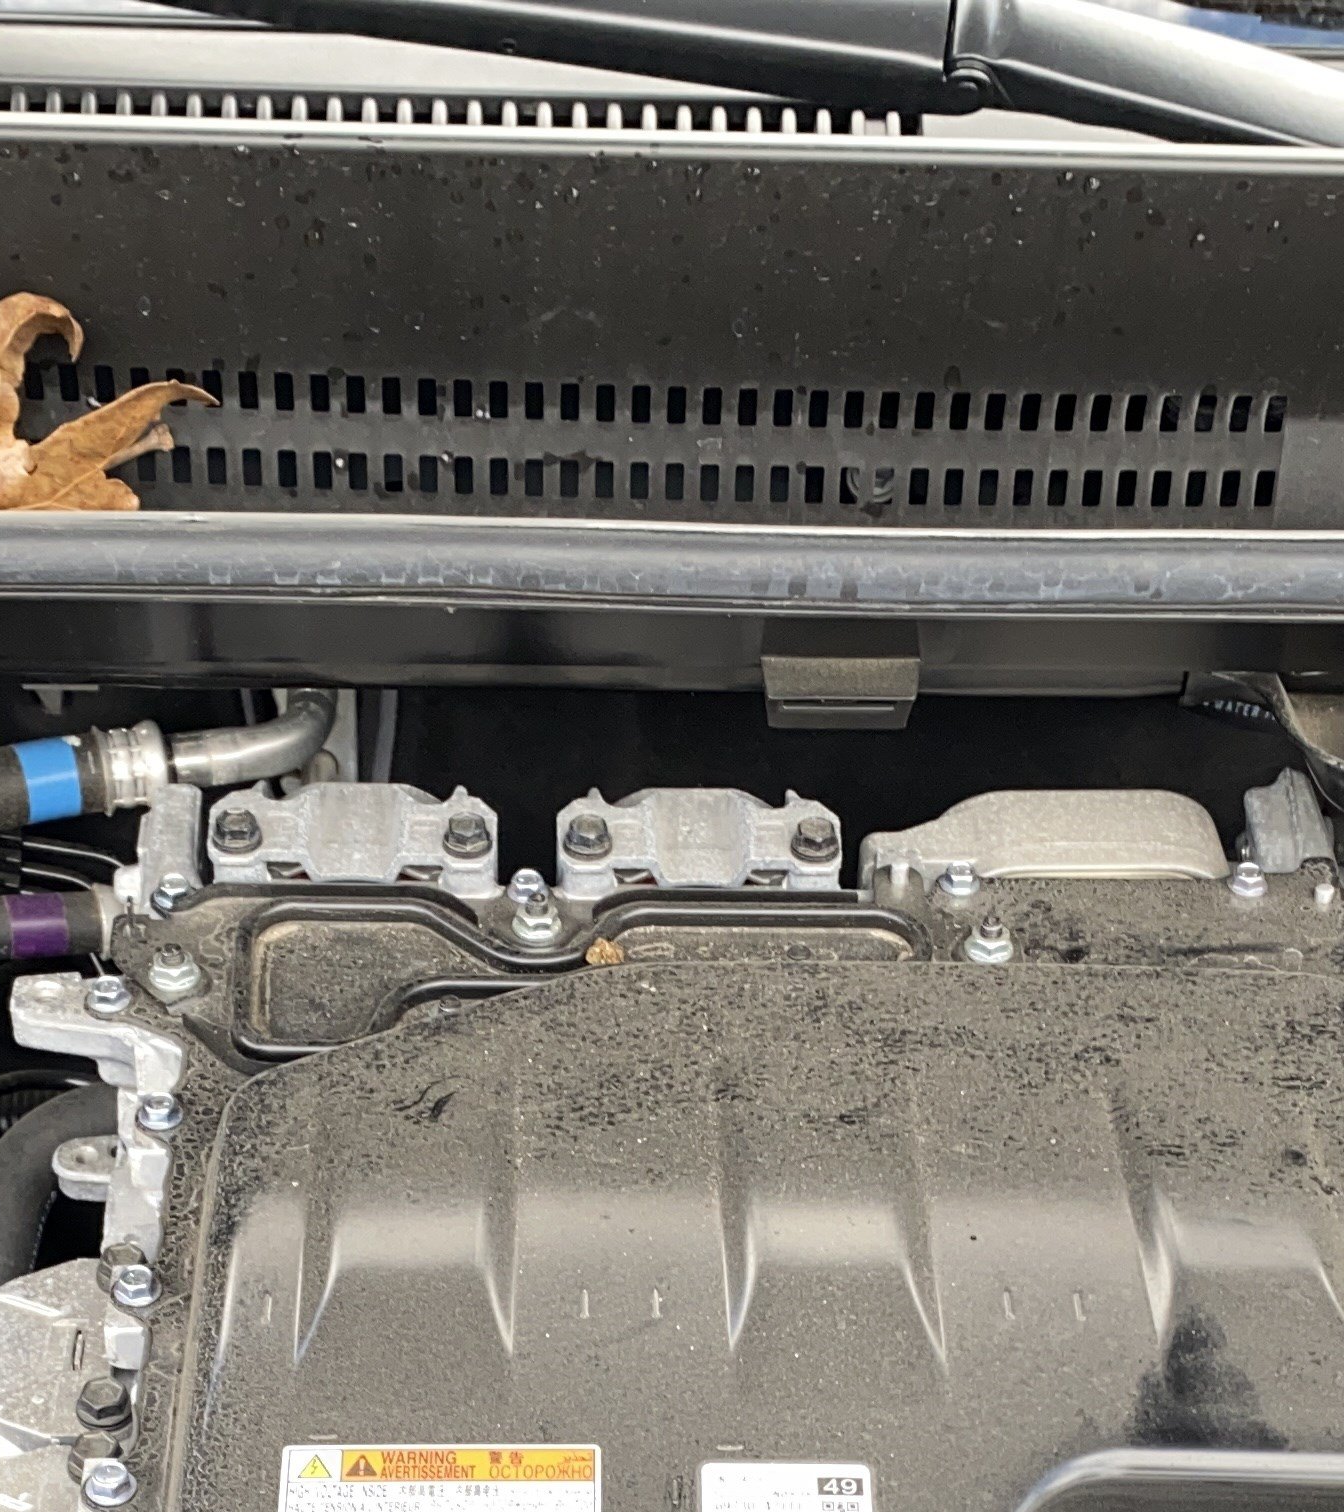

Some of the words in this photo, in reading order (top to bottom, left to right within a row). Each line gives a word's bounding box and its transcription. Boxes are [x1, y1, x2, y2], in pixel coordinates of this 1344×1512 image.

[381, 1451, 456, 1465] WARNING
[380, 1465, 476, 1480] AVERTISSEMENT
[489, 1465, 592, 1480] ОСТОРОЖНО
[822, 1478, 857, 1495] 49
